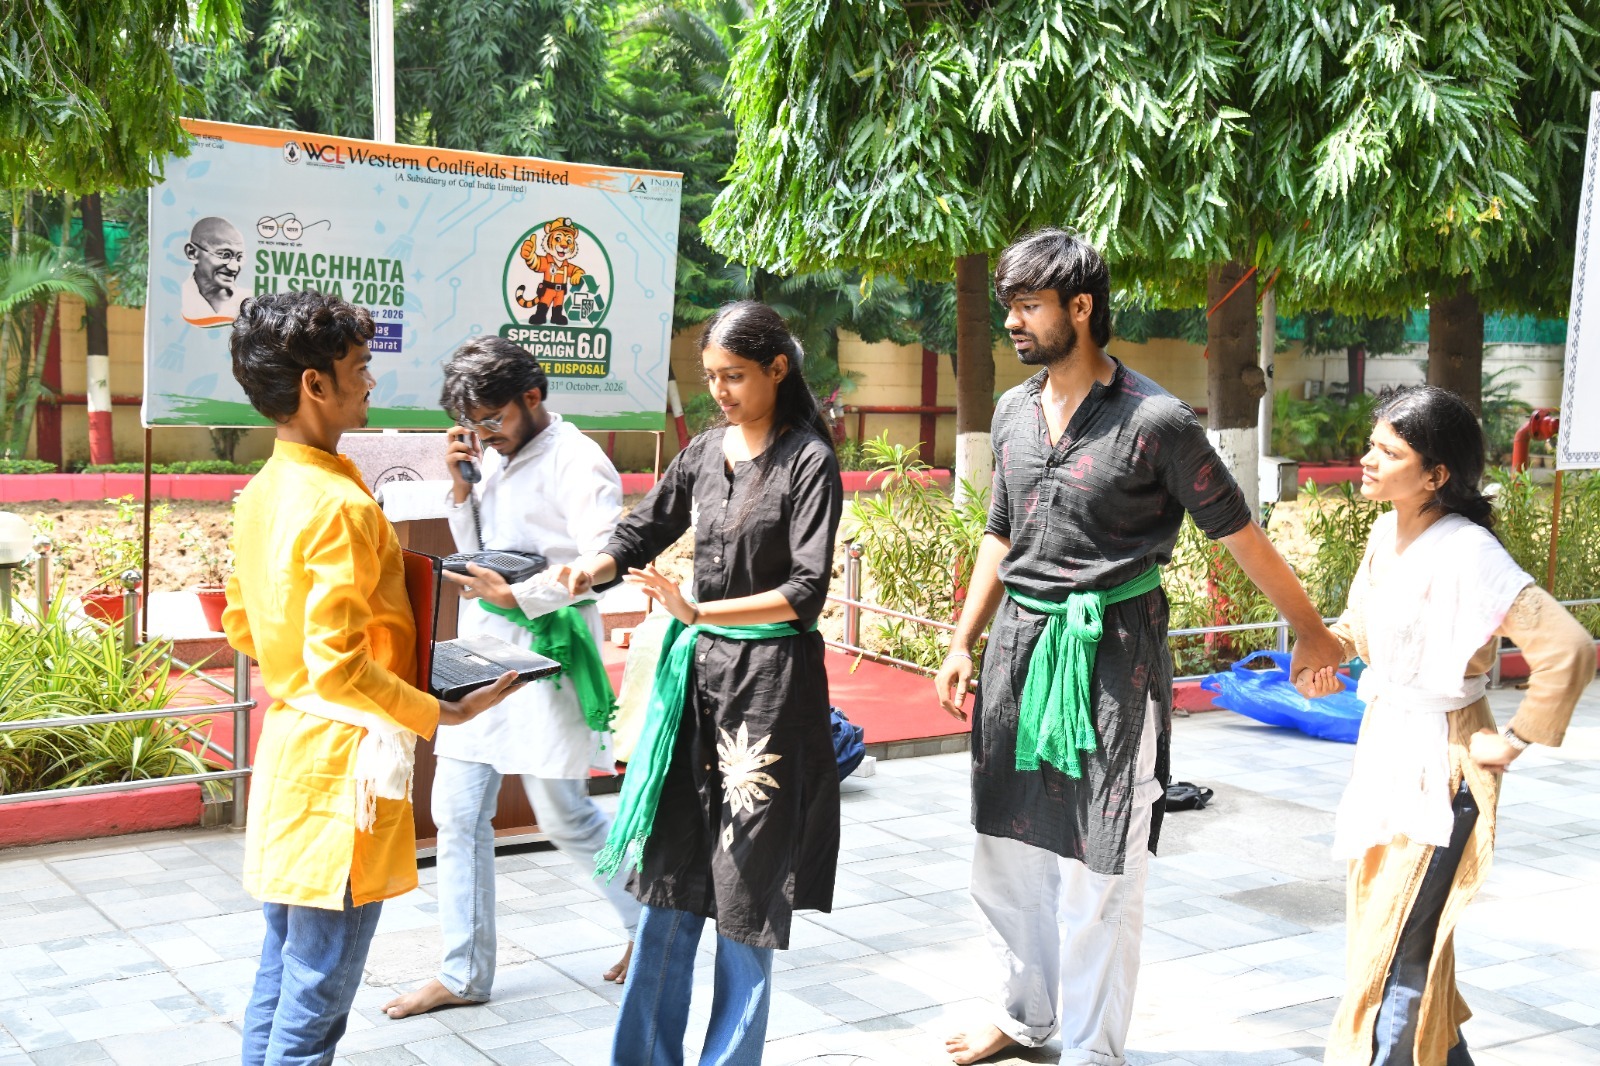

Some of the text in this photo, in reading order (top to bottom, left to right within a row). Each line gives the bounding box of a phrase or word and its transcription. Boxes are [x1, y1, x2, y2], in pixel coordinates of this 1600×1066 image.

[302, 142, 346, 165] WCL
[347, 146, 570, 186] Western Coalfields Limited
[406, 173, 447, 187] Subsidiary
[448, 179, 457, 187] of
[458, 179, 476, 189] Coal
[477, 180, 496, 191] India
[498, 184, 527, 195] Limited)
[650, 178, 680, 188] INDIA
[254, 248, 405, 284] SWACHHATA
[254, 275, 278, 297] HI
[352, 282, 405, 307] 2026
[382, 309, 404, 320] 2026
[367, 339, 398, 350] Bharat
[507, 328, 576, 344] SPECIAL
[577, 332, 607, 360] 6.0
[554, 362, 606, 375] DISPOSAL
[565, 381, 602, 392] October,
[604, 382, 624, 392] 2026
